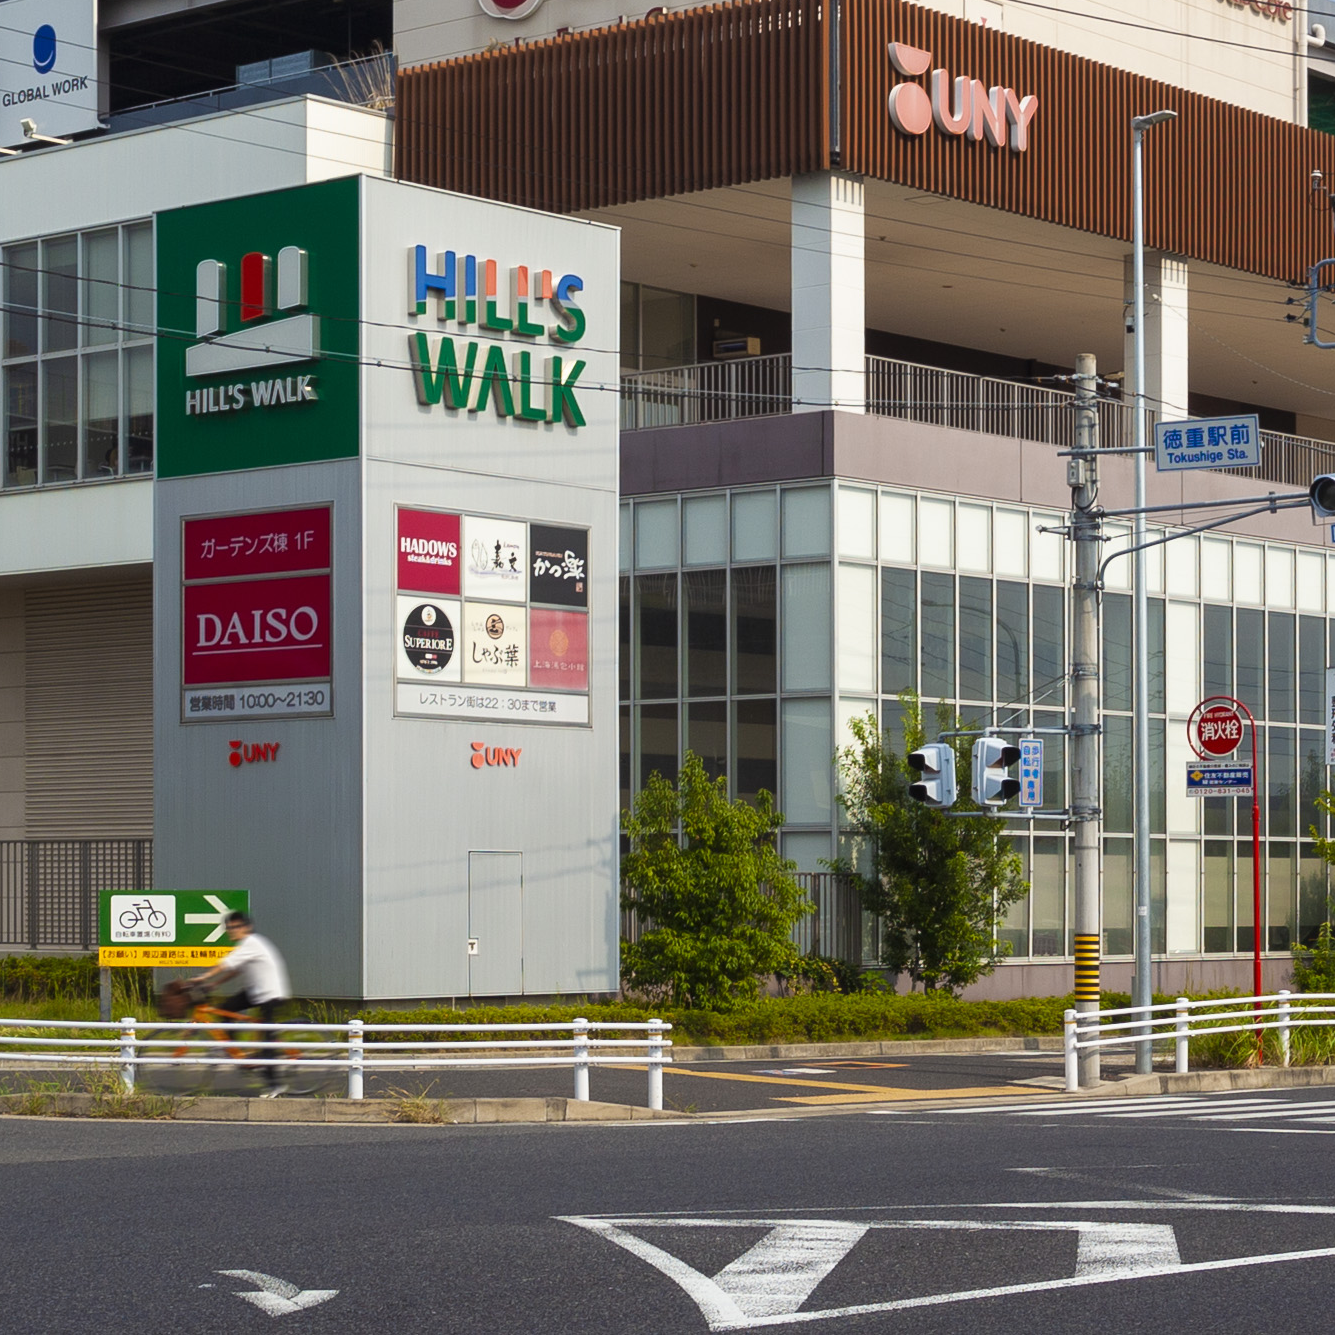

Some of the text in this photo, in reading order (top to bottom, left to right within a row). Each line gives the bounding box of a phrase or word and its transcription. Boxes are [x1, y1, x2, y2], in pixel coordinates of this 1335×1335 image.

[1, 75, 89, 108] GLOBAL WORK
[931, 68, 1039, 153] UNY
[408, 243, 587, 344] HILL'S
[408, 331, 588, 429] WALK
[185, 375, 313, 416] HILL'S WALK
[1162, 424, 1251, 450] 徳重駅前
[1167, 449, 1249, 465] Tokushige Sta.
[201, 530, 314, 559] ガーデンズ棟 1F
[400, 536, 458, 558] HADOWS
[196, 606, 319, 647] DAISO
[404, 634, 453, 651] SUPERIORE
[472, 641, 519, 667] しゃぶ葉
[189, 694, 236, 713] 営業時間
[1200, 719, 1239, 741] 消火栓
[243, 742, 280, 763] UNY
[485, 747, 522, 768] UNY
